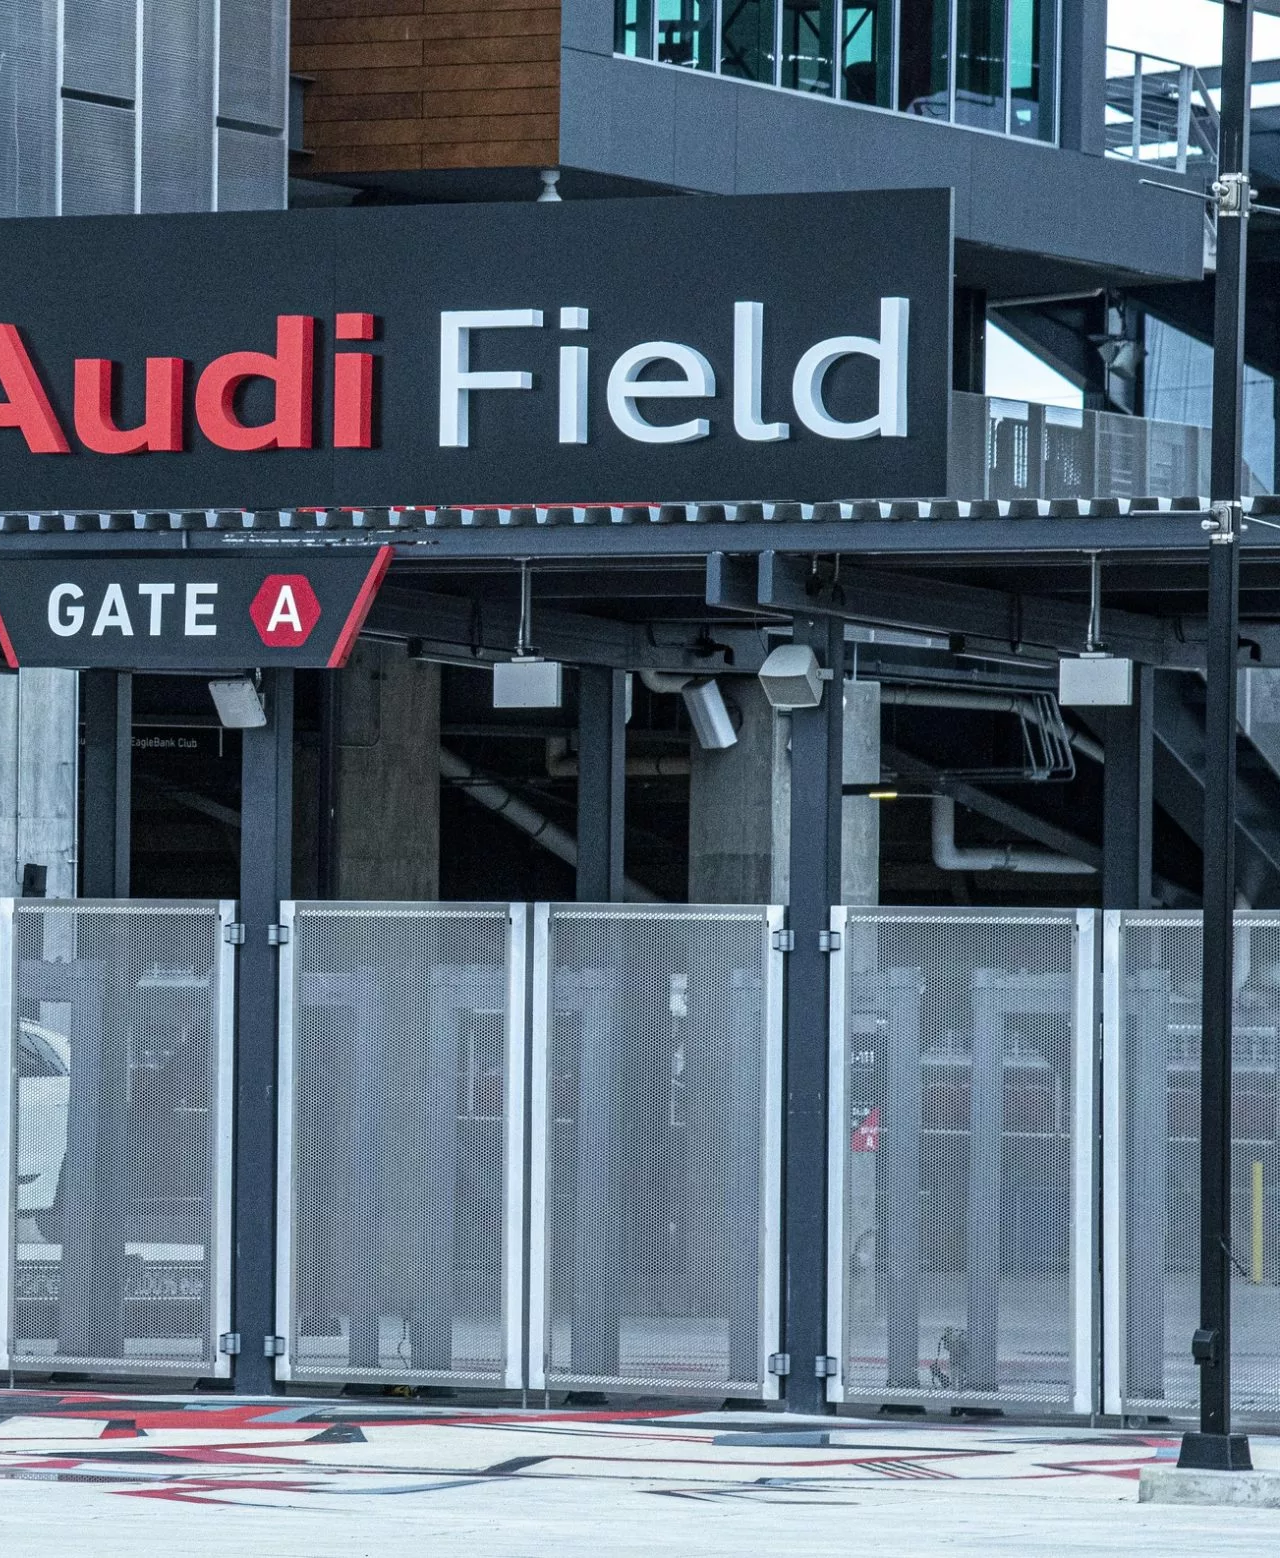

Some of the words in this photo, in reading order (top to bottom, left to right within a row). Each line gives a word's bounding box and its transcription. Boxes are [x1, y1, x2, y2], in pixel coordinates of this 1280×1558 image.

[439, 297, 910, 446] Field
[48, 583, 218, 637] GATE
[267, 585, 302, 632] A
[177, 738, 198, 748] Club
